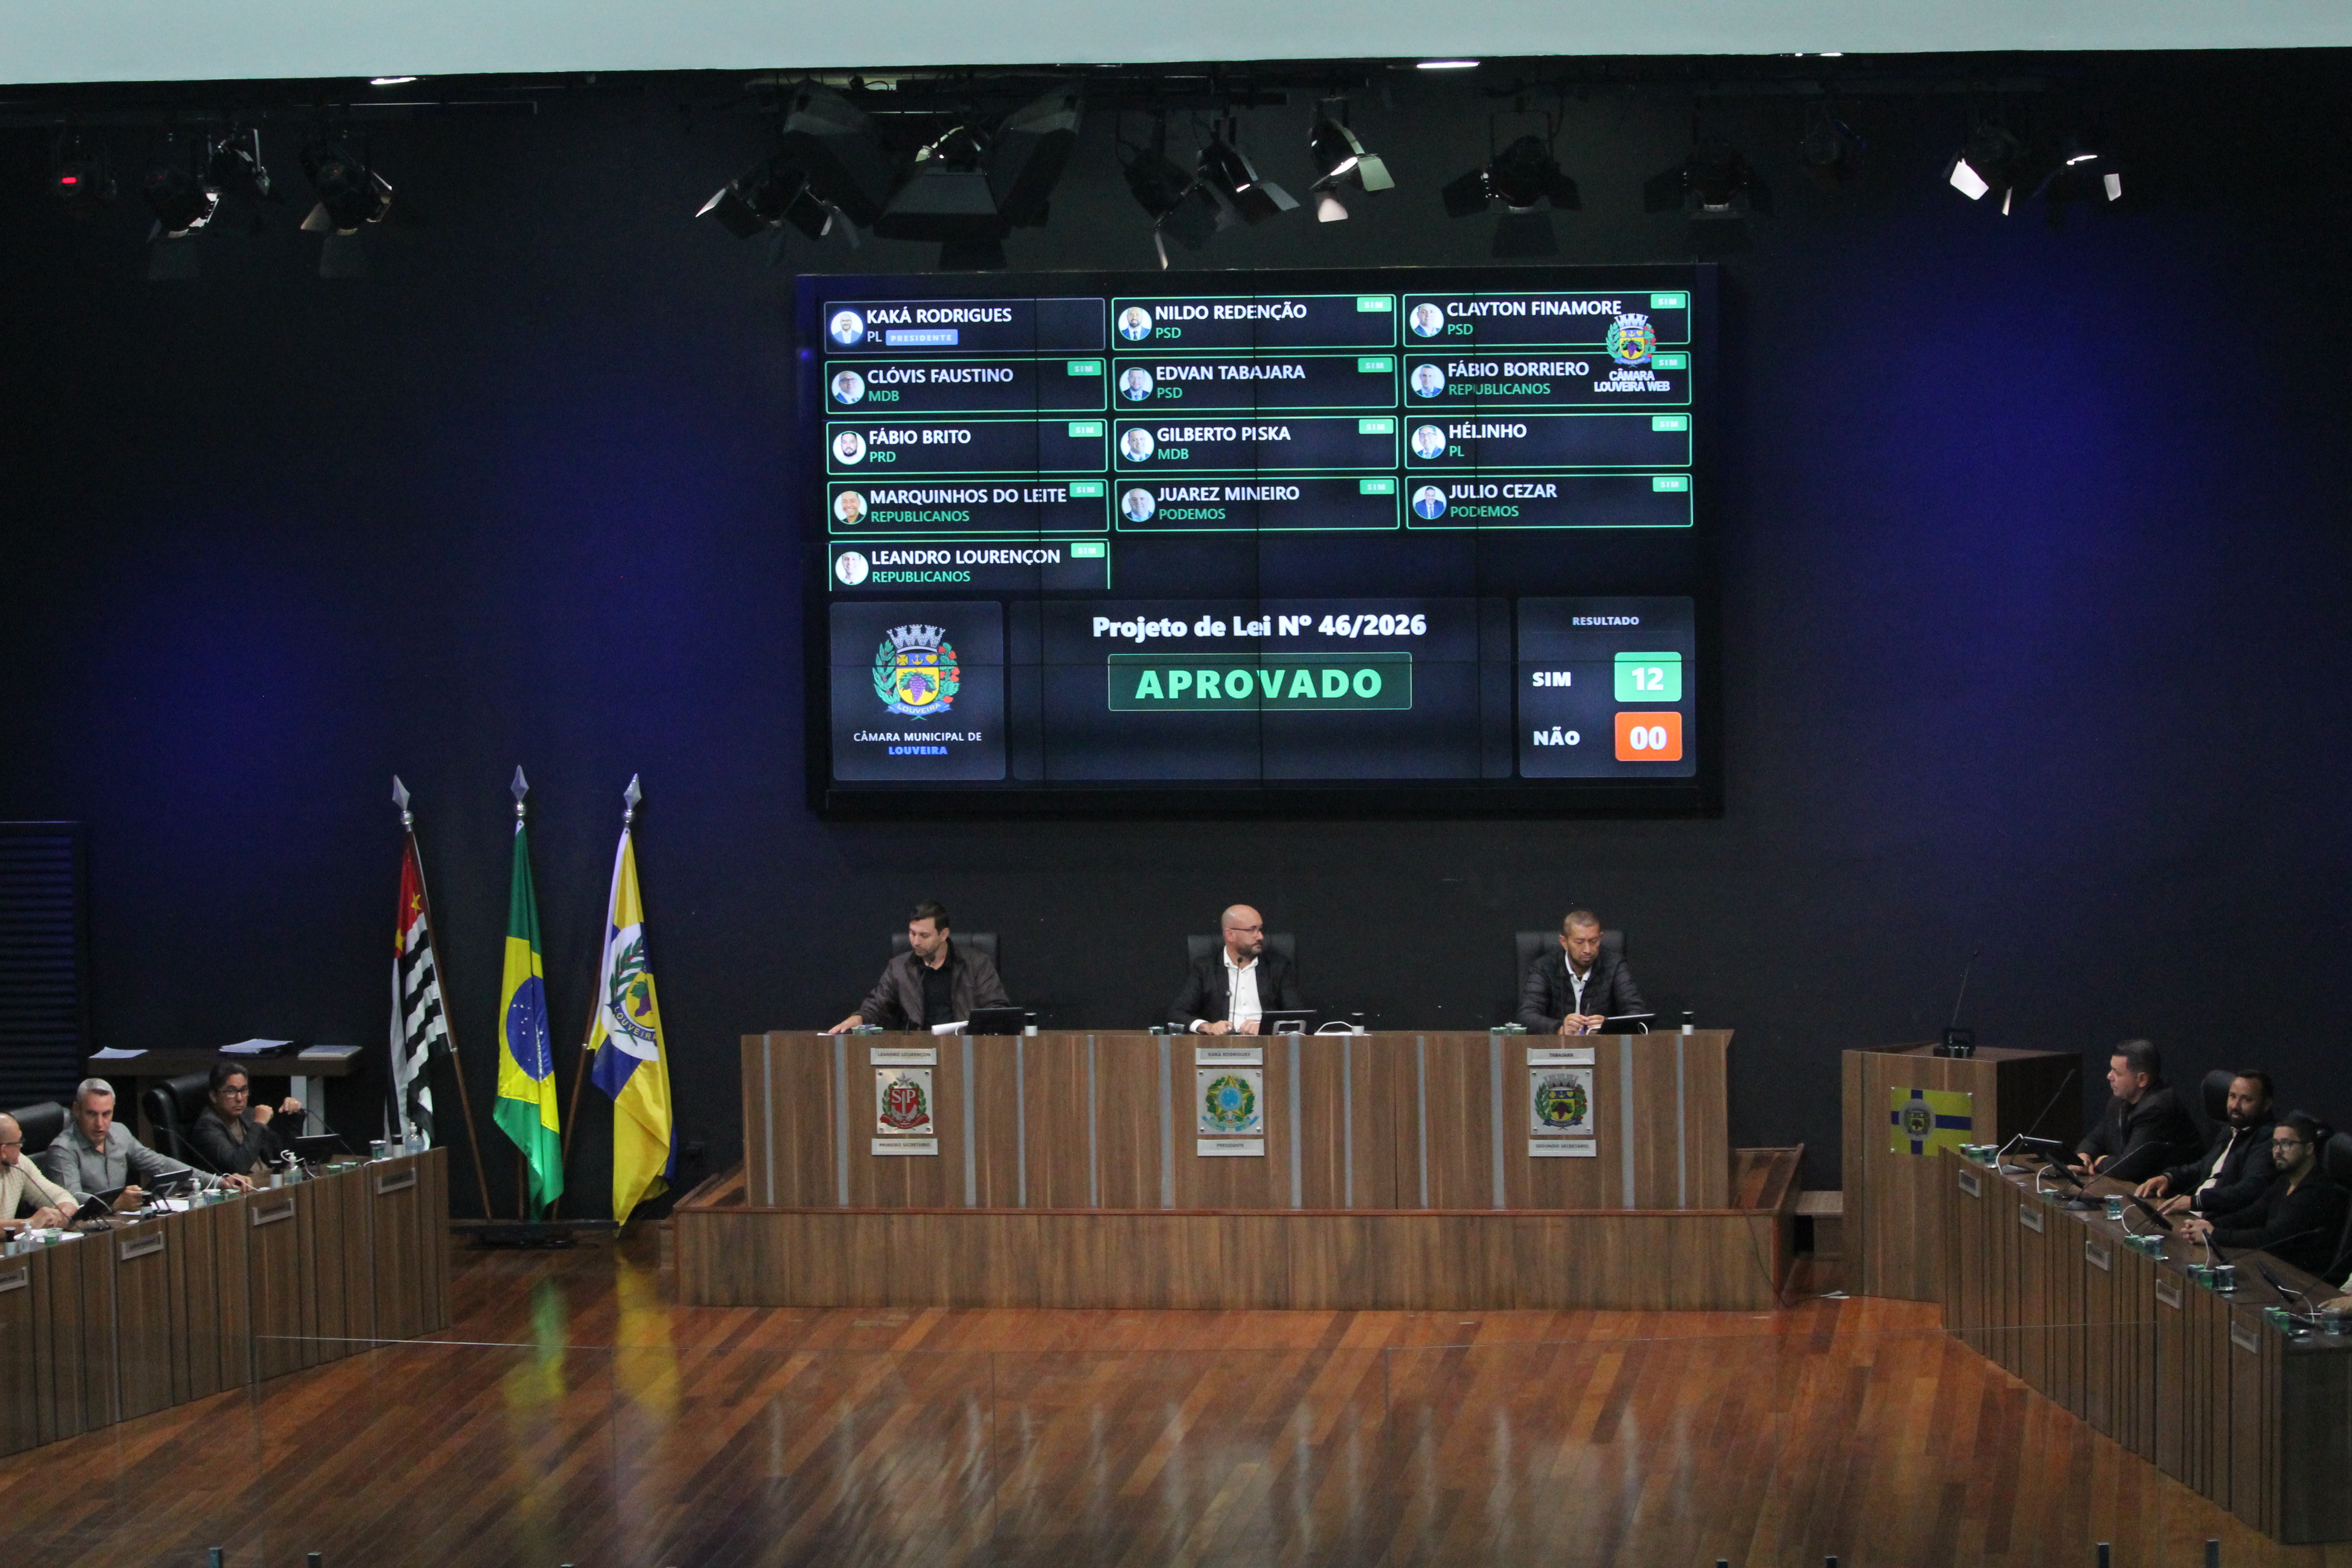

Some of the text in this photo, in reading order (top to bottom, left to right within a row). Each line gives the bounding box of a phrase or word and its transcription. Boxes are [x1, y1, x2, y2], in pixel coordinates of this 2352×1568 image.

[1156, 301, 1307, 320] NILDO REDENÇÃO
[1447, 300, 1622, 316] CLAYTON FINAMORE
[867, 307, 1012, 323] KAKÁ RODRIGUES
[1156, 328, 1181, 338] PSD
[1448, 324, 1473, 334] PSD
[867, 332, 882, 342] PL
[1156, 365, 1306, 380] EDVAN TABAJARA
[1448, 360, 1589, 377] FÁBIO BORRIERO
[1609, 368, 1655, 381] CÂMARA
[867, 367, 1013, 383] CLÓVIS FAUSTINO
[1157, 387, 1182, 398] PSD
[1449, 383, 1550, 395] REPUBLICANOS
[1594, 381, 1671, 392] LOUVEIRA WEB
[869, 391, 899, 401] MDB
[1157, 426, 1291, 441] GILBERTO PISKA
[1450, 421, 1527, 438] HÉLINHO
[869, 428, 971, 444] FÁBIO BRITO
[870, 451, 896, 462] PRD
[1158, 449, 1189, 459] MDB
[1450, 446, 1464, 456] PL
[871, 489, 1067, 505] MARQUINHOS DO LEITE
[1157, 486, 1299, 501] JUAREZ MINEIRO
[1449, 484, 1558, 498] JULIO CEZAR
[871, 511, 970, 522] REPUBLICANOS
[1159, 509, 1225, 519] PODEMOS
[1451, 506, 1519, 517] PODEMOS
[872, 549, 1060, 565] LEANDRO LOURENÇON
[872, 571, 970, 582] REPUBLICANOS
[1573, 617, 1639, 625] RESULTADO
[1093, 614, 1426, 643] Projeto de Lei Nº 46/2026
[1135, 669, 1382, 699] APROVADO
[1533, 667, 1664, 690] SIM 12
[897, 703, 941, 713] LOUVEIRA
[854, 730, 982, 741] CÂMARA MUNICIPAL DE
[1534, 726, 1667, 750] NÃO 00
[888, 746, 948, 755] LOUVEIRA
